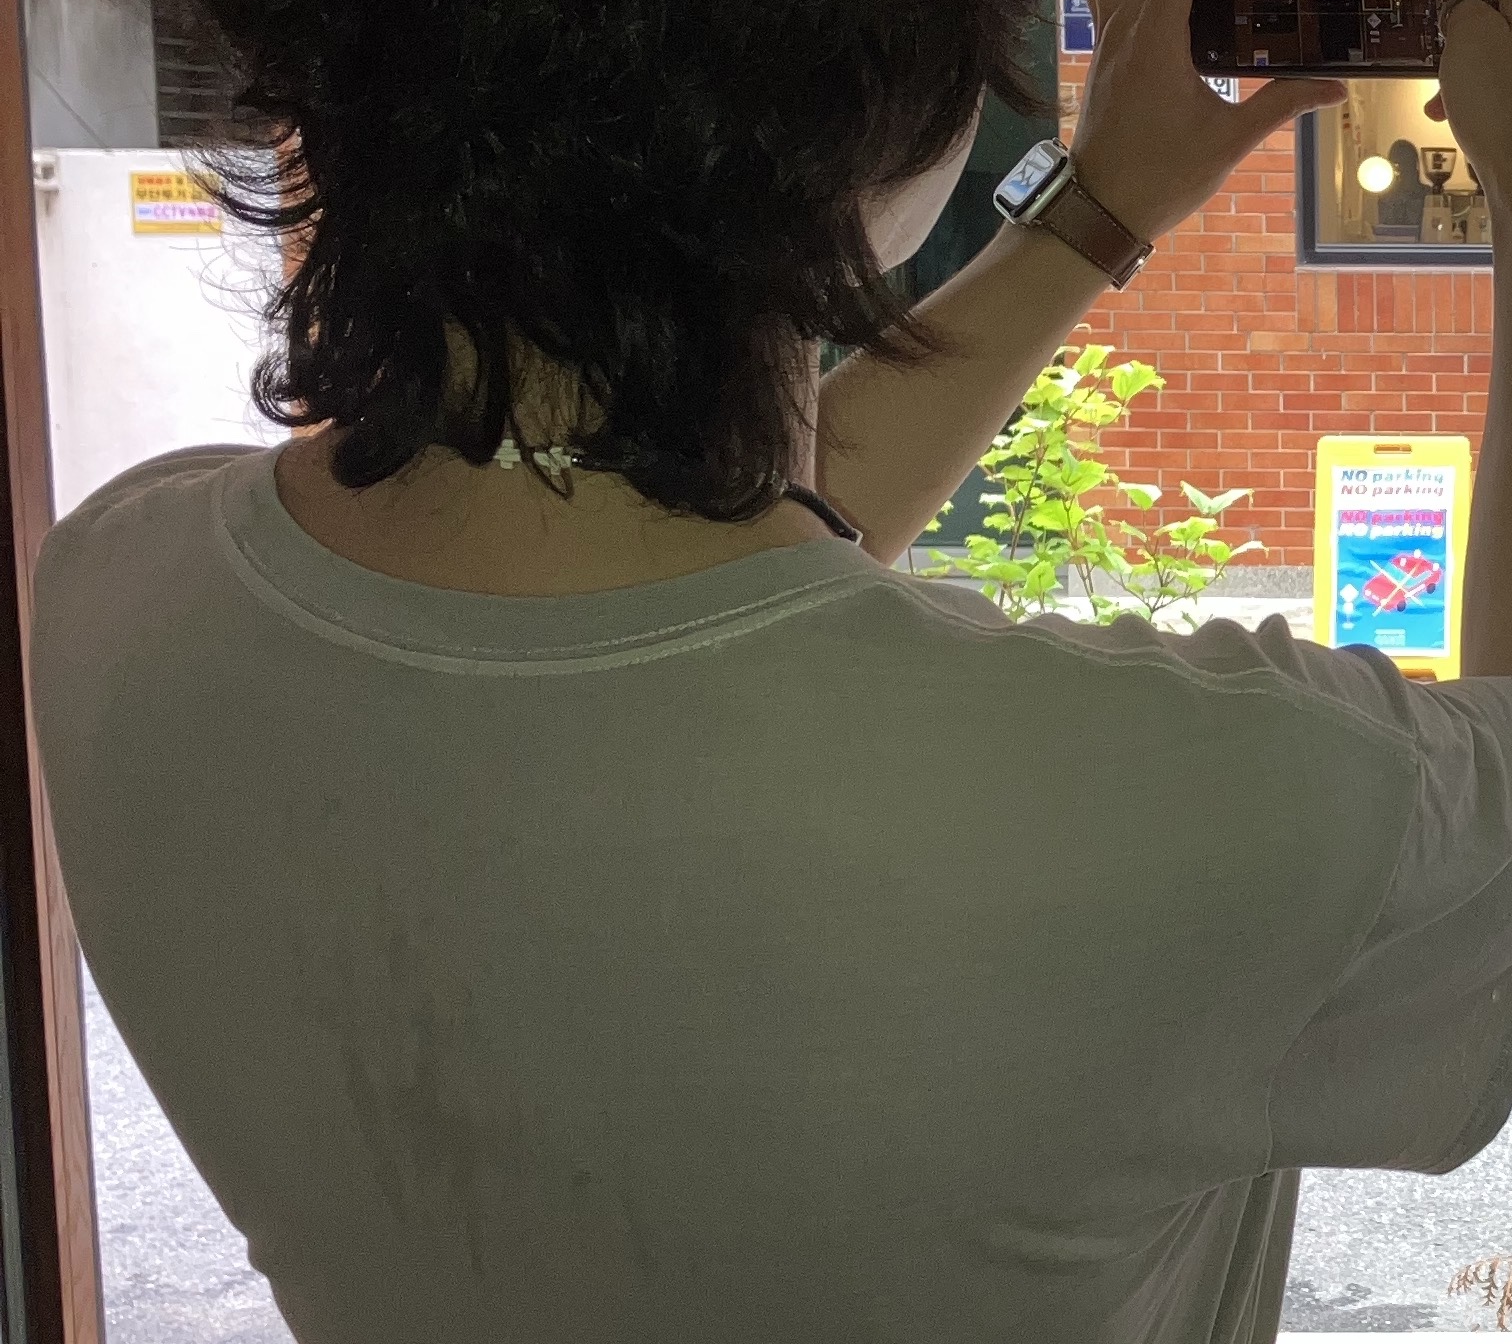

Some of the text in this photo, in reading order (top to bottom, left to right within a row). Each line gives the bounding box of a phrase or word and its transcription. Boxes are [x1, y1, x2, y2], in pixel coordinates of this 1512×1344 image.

[1341, 469, 1445, 484] NO parking
[1340, 485, 1444, 497] NO parking
[1340, 511, 1444, 526] NO parking
[1339, 524, 1445, 540] NO parking
